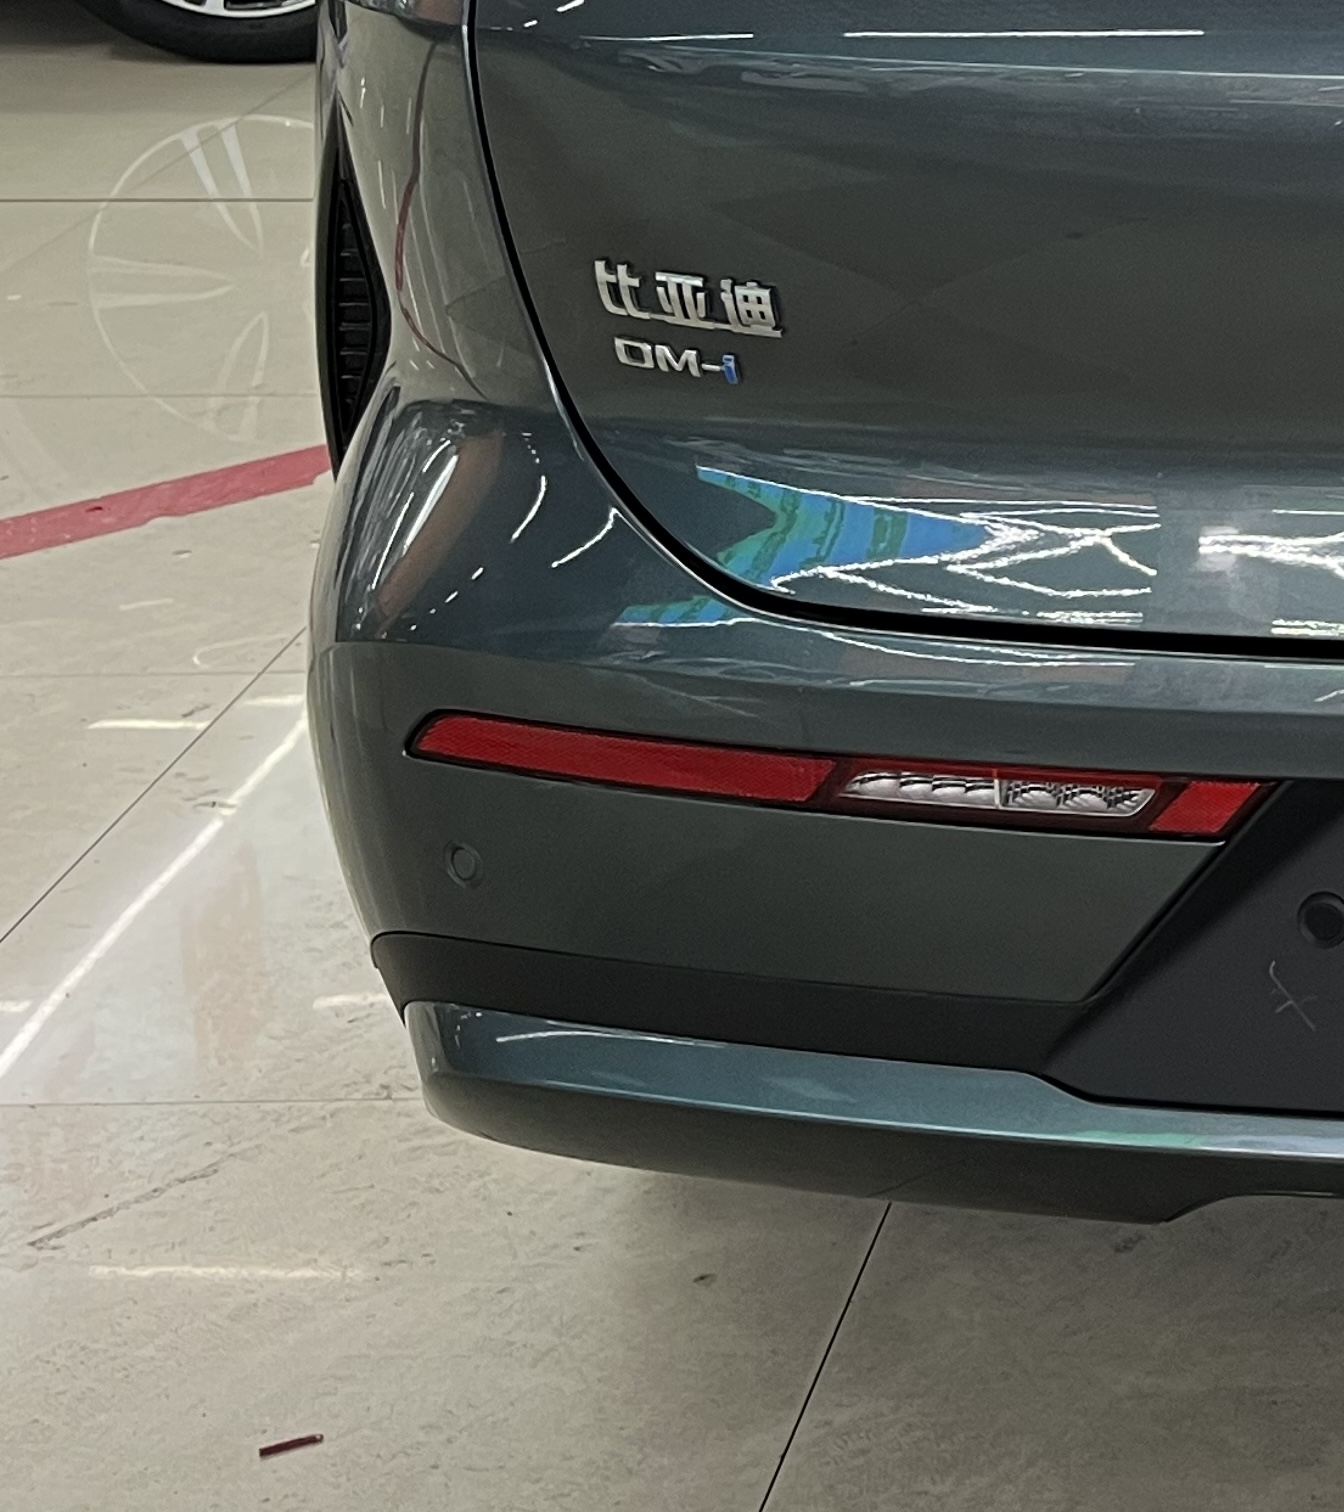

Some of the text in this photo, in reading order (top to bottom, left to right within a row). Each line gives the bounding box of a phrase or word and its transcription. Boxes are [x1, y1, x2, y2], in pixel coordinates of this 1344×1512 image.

[594, 259, 782, 338] 比亚迪
[613, 336, 738, 385] DM-i
